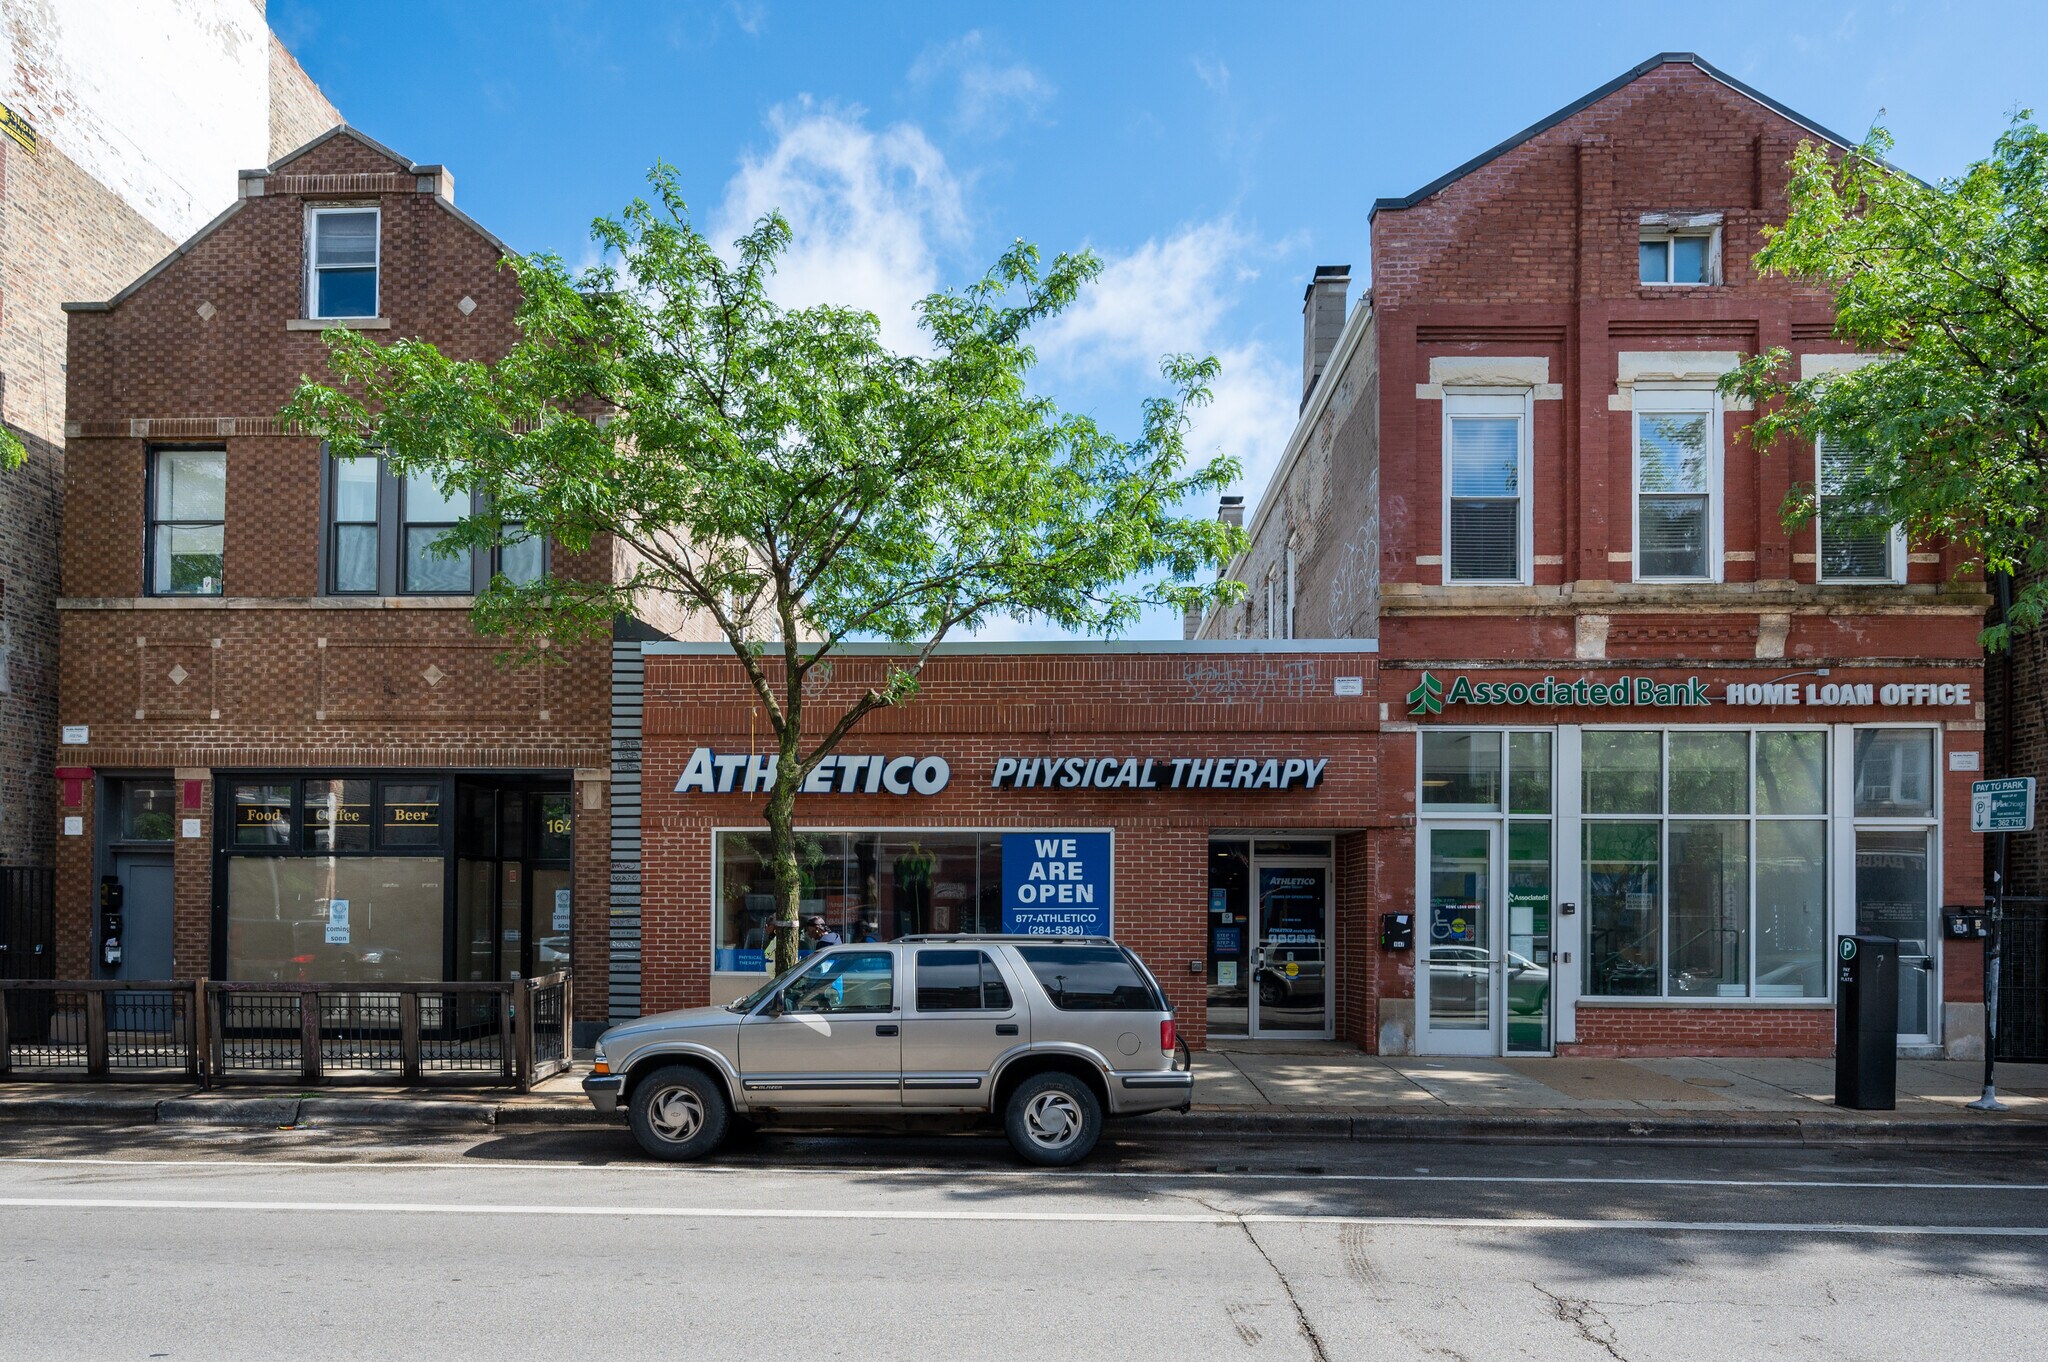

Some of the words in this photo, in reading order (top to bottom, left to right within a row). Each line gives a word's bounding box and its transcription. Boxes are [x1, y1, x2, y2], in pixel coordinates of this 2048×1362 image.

[1449, 676, 1630, 706] Associated
[1633, 676, 1712, 706] Bank
[1726, 684, 1800, 706] HOME
[1806, 684, 1874, 706] LOAN
[1880, 684, 1970, 706] OFFICE
[674, 748, 950, 795] ATHETICO
[992, 758, 1156, 788] PHYSICAL
[1170, 758, 1328, 788] THERAPY
[2003, 781, 2023, 790] PARK
[248, 809, 280, 821] Food
[316, 809, 360, 821] Cffee
[394, 809, 429, 821] Beer
[1035, 839, 1077, 858] WE
[1028, 862, 1083, 880] ARE
[1270, 877, 1316, 885] ATHLETICO
[1018, 884, 1094, 903] OPEN
[1016, 914, 1096, 923] 877-ATHLETICO
[1028, 926, 1083, 935] (284-5384)
[1844, 942, 1852, 956] P
